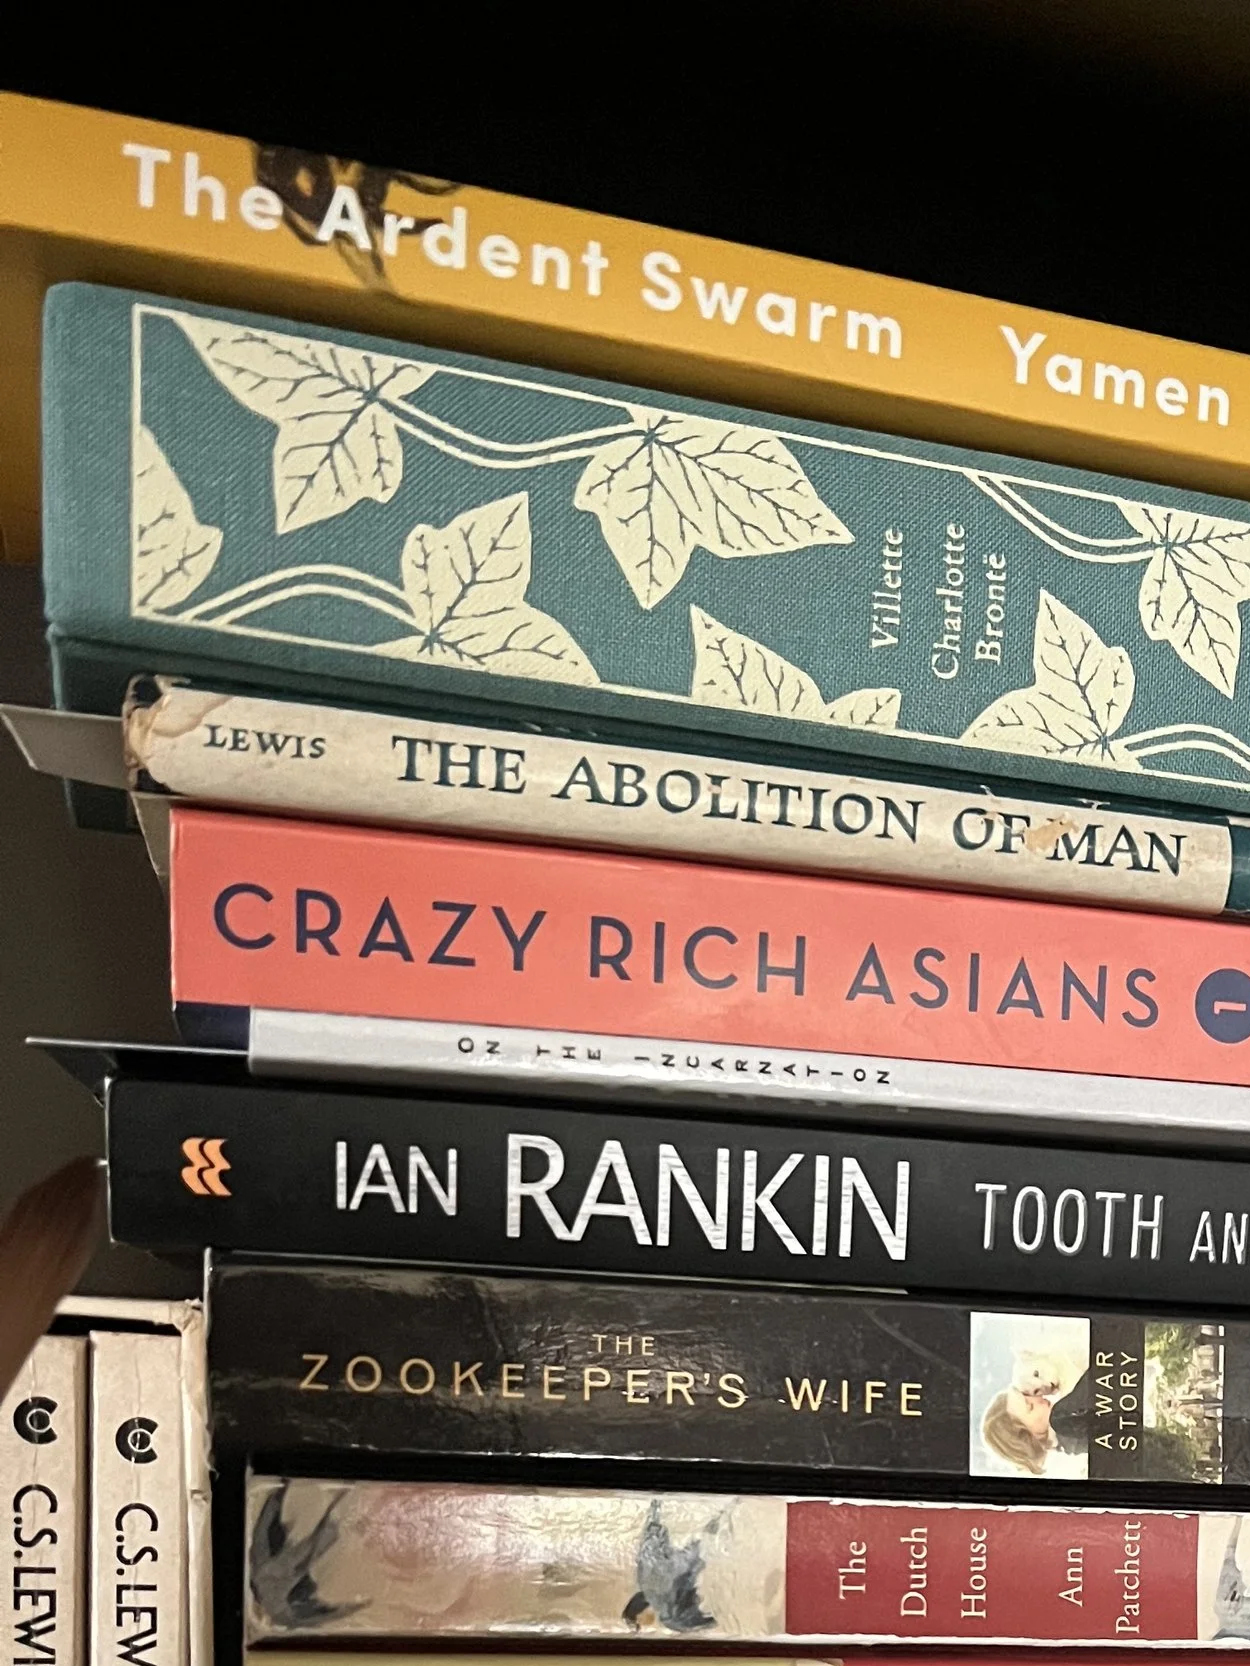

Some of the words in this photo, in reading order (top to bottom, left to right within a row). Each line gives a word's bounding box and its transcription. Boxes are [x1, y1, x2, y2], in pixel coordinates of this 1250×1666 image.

[123, 143, 281, 231] The
[316, 187, 609, 297] Ardent
[641, 251, 904, 358] Swarm
[1000, 325, 1231, 427] Yamen
[871, 525, 904, 649] Villette
[932, 521, 966, 681] Charlotte
[973, 551, 1006, 665] Brontë
[202, 723, 327, 760] LEWIS
[393, 735, 528, 795] THE
[551, 755, 926, 844] ABOLITION
[953, 806, 1028, 854] OF
[1047, 818, 1187, 878] MAN
[212, 881, 547, 973] CRAZY
[588, 914, 806, 997] RICH
[845, 942, 1161, 1030] ASIANS
[458, 1036, 500, 1055] ON
[536, 1044, 602, 1061] THE
[634, 1053, 890, 1085] INCARNATION
[336, 1140, 457, 1216] IAN
[506, 1133, 909, 1261] RANKIN
[975, 1183, 1164, 1262] TOOTH
[299, 1353, 745, 1410] ZOOKEEPER'S
[784, 1377, 923, 1417] WIFE
[591, 1333, 655, 1357] THE
[1096, 1350, 1115, 1421] WAR
[1095, 1432, 1112, 1451] A
[1118, 1351, 1139, 1451] STORY
[839, 1541, 867, 1599] The
[900, 1526, 928, 1618] Dutch
[960, 1527, 987, 1619] House
[1058, 1546, 1083, 1607] Ann
[1115, 1520, 1141, 1633] Patchett
